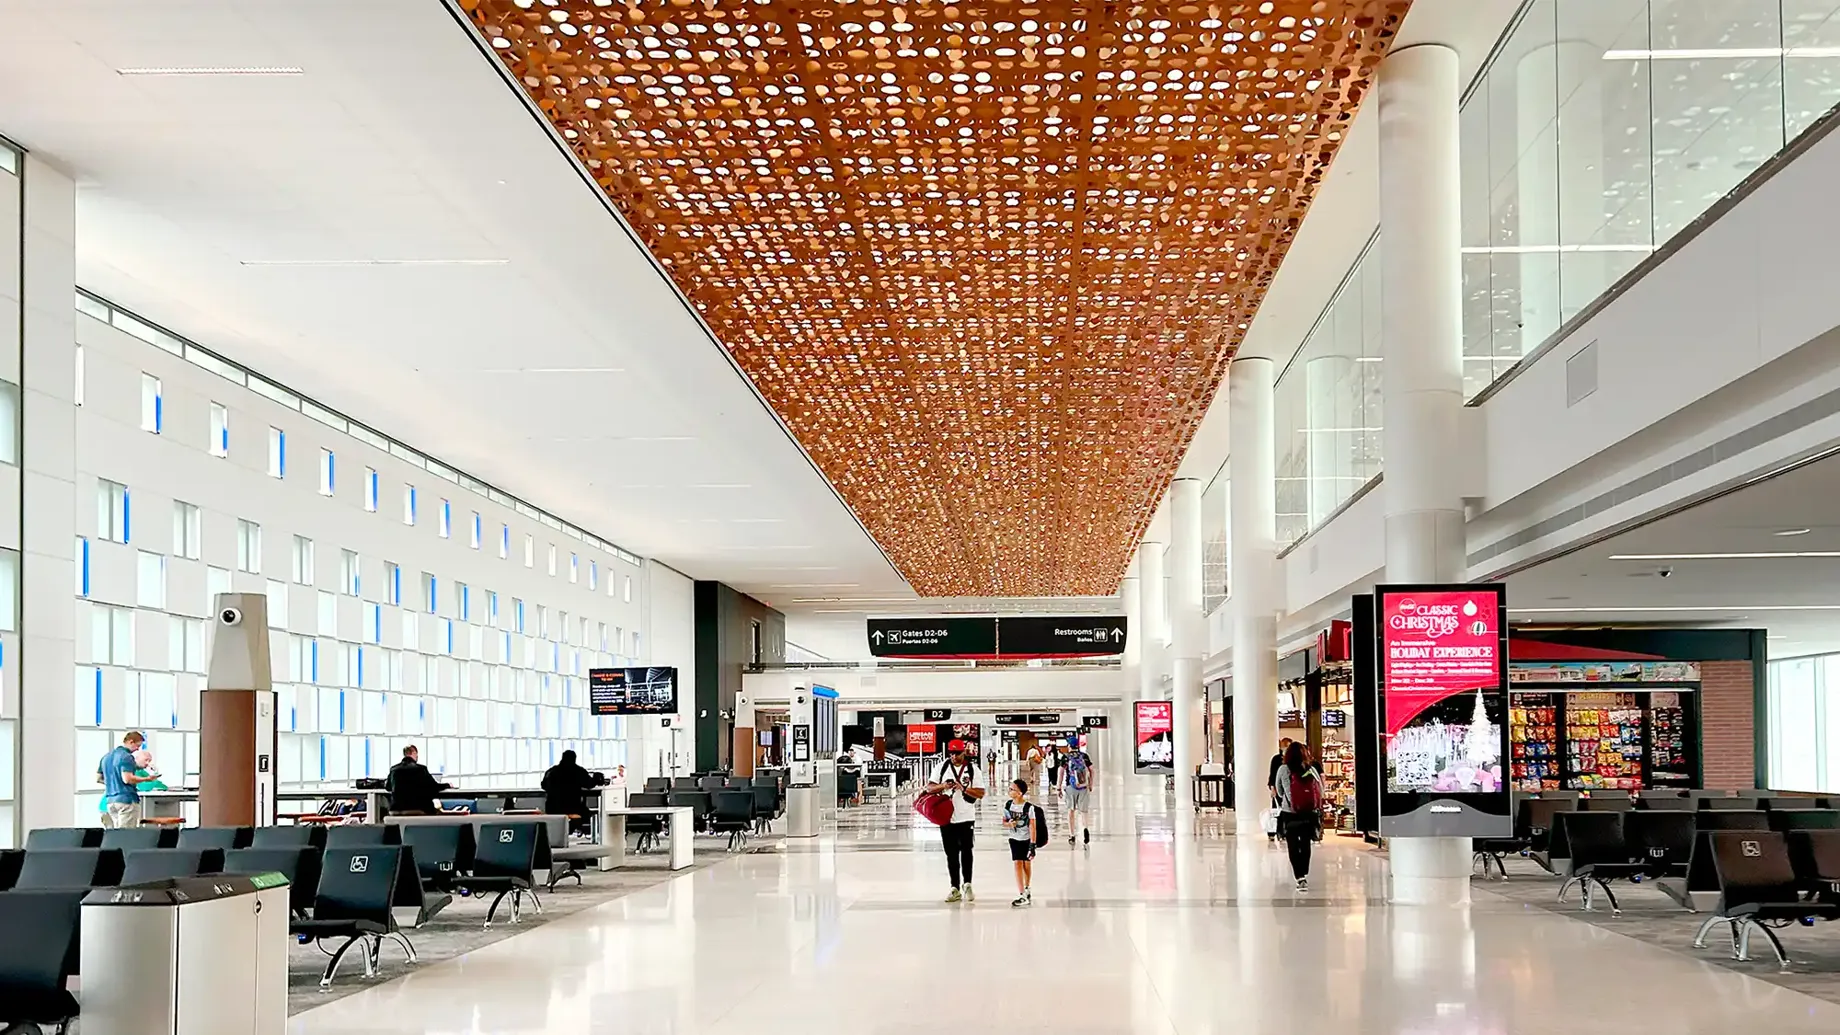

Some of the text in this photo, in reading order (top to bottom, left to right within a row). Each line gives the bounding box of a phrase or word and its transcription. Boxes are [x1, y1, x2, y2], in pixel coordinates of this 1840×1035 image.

[1416, 605, 1458, 615] CLASSIC
[1390, 615, 1459, 637] CHRISTMAS
[924, 629, 948, 637] D2-D6
[1054, 628, 1093, 636] Restrooms
[1390, 646, 1493, 659] HOLIDAY EXPERIENCE
[932, 710, 943, 718] D2
